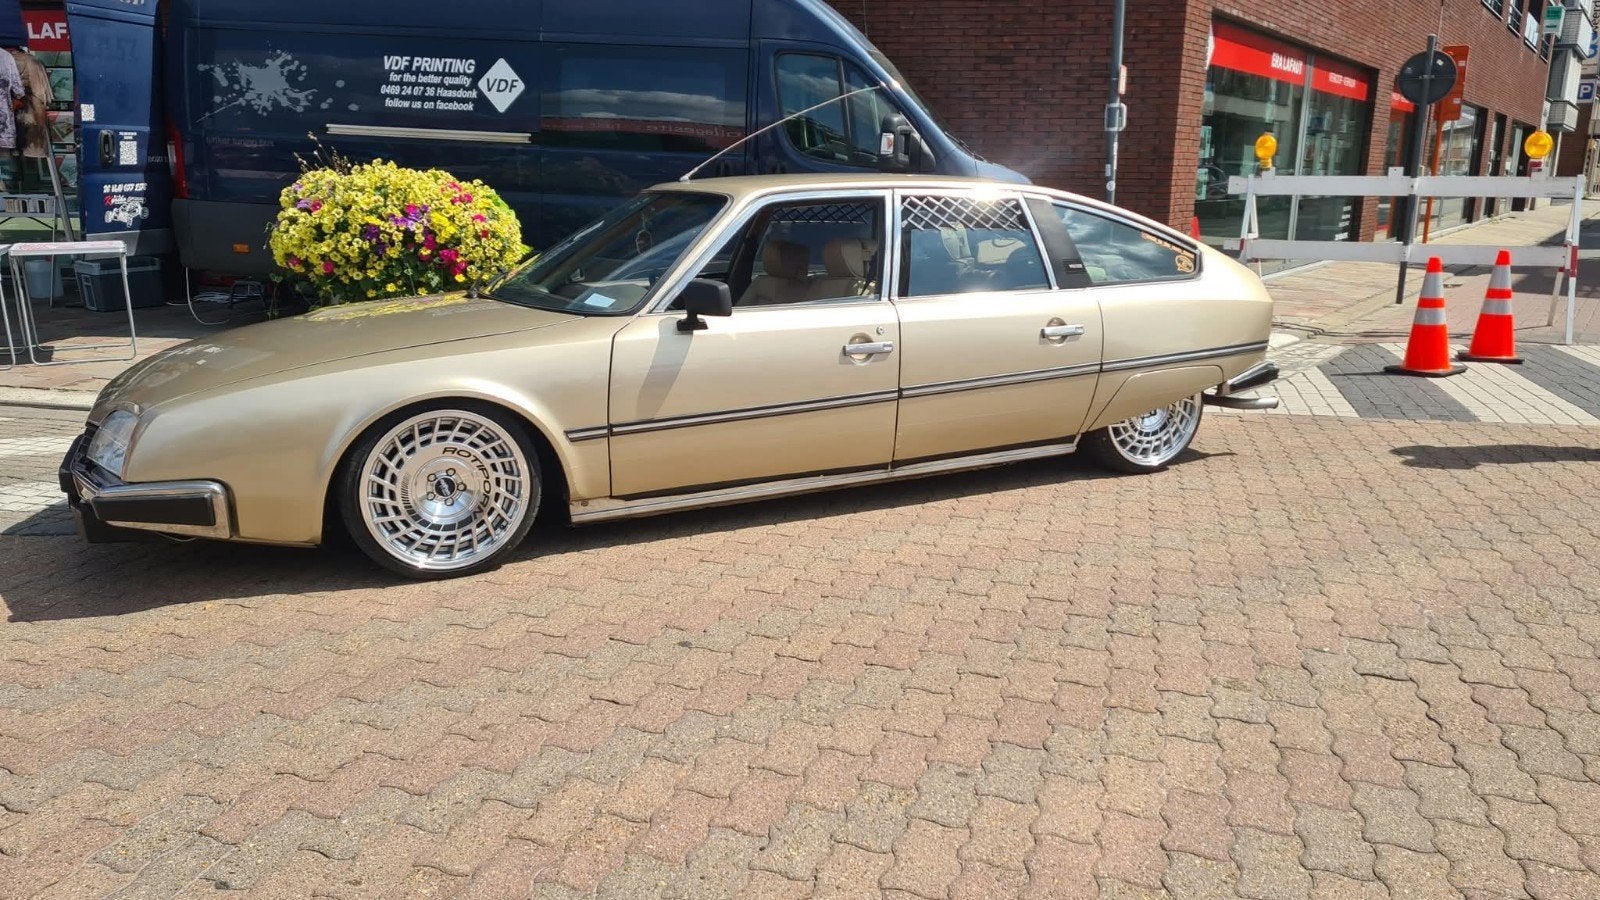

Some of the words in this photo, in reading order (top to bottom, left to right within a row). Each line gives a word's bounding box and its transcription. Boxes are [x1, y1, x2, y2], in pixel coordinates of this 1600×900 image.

[27, 22, 70, 39] LAF
[384, 55, 411, 70] VDF
[412, 57, 476, 74] PRINTING
[390, 72, 402, 81] for
[403, 73, 417, 82] the
[417, 73, 442, 84] better
[443, 75, 472, 87] quality
[486, 78, 519, 93] VDF
[380, 84, 401, 95] 0469
[401, 86, 412, 95] 24
[413, 86, 424, 96] 07
[424, 87, 436, 97] 36
[436, 88, 478, 99] Haasdonk
[1580, 84, 1592, 98] P
[385, 97, 411, 108] follow
[411, 101, 422, 109] us
[436, 100, 474, 111] facebook
